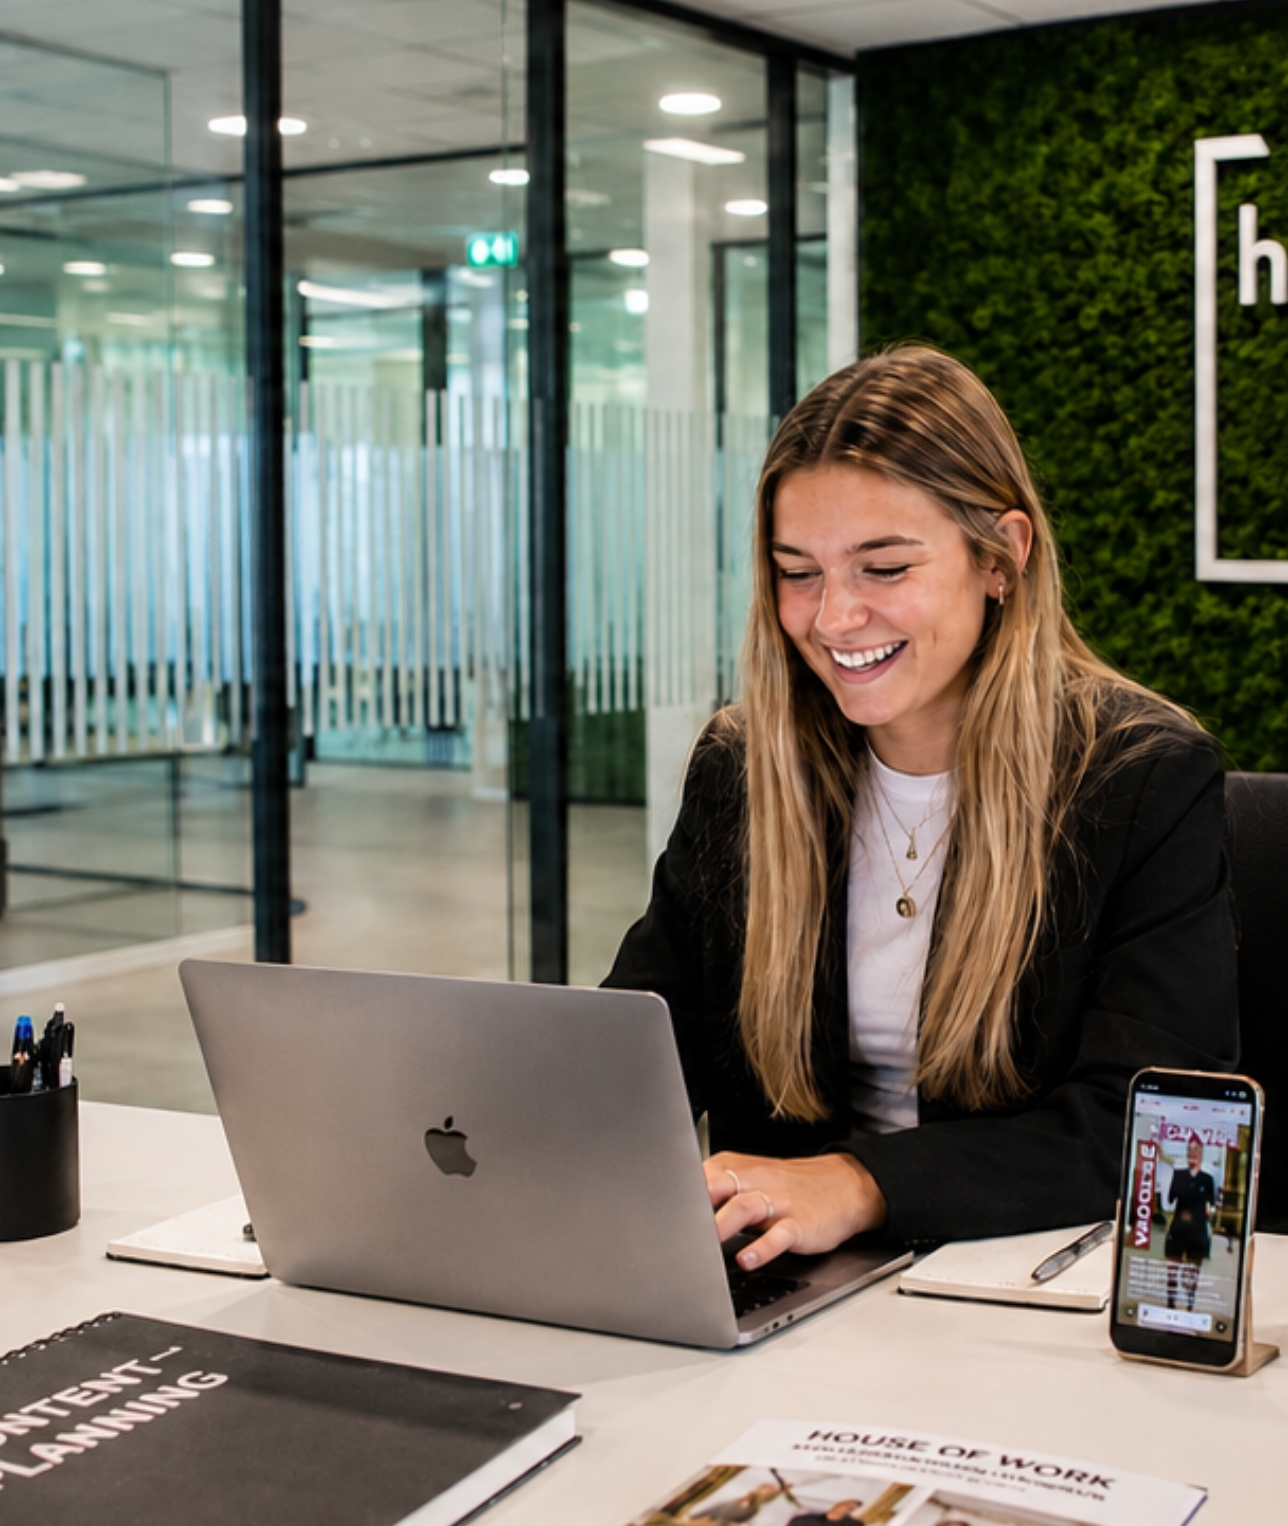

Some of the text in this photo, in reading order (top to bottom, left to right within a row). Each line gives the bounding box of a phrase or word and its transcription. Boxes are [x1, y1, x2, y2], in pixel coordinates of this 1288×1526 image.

[808, 1430, 930, 1452] HOUSE
[938, 1445, 990, 1460] OF
[999, 1455, 1117, 1490] WORK
